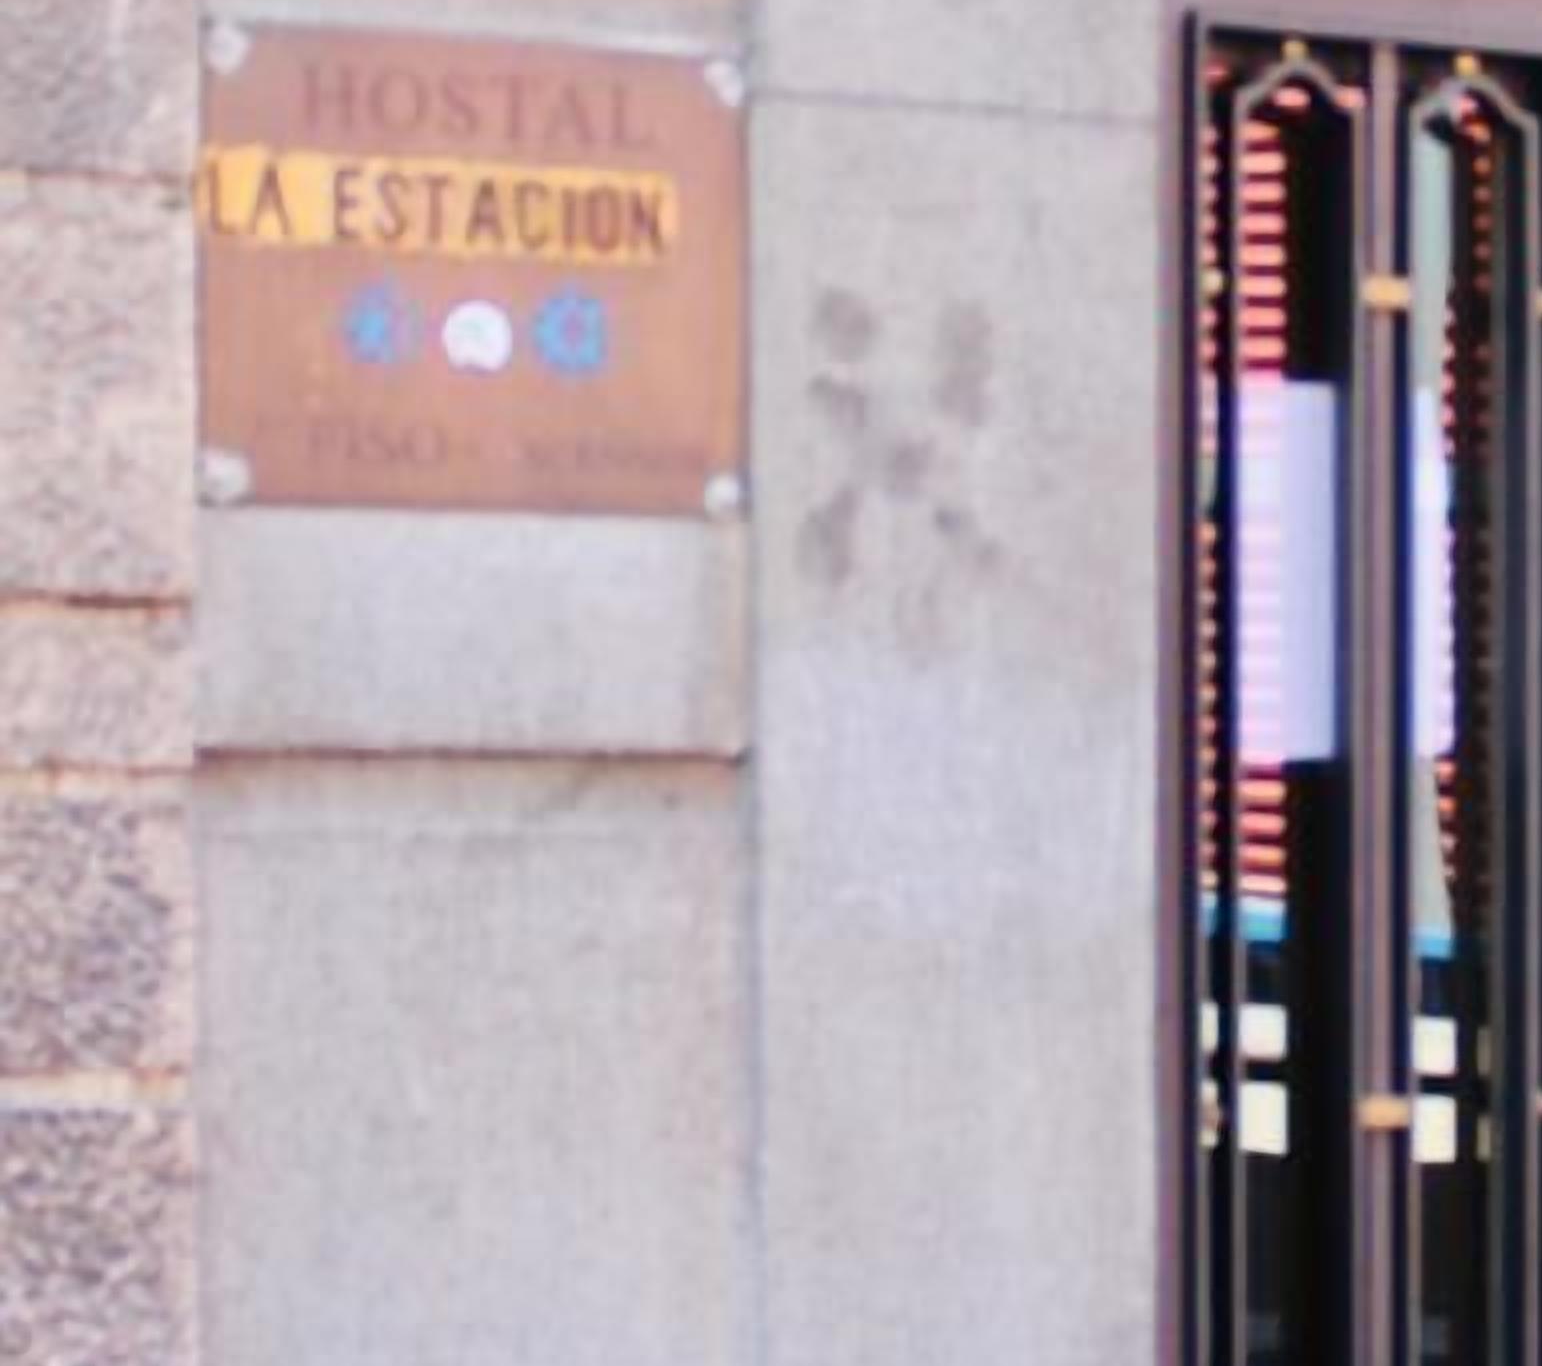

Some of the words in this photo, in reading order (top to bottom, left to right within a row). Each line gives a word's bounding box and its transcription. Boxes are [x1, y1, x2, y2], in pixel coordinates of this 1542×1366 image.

[302, 63, 655, 149] HOSTAL
[205, 159, 291, 238] LA
[333, 165, 665, 255] ESTACION
